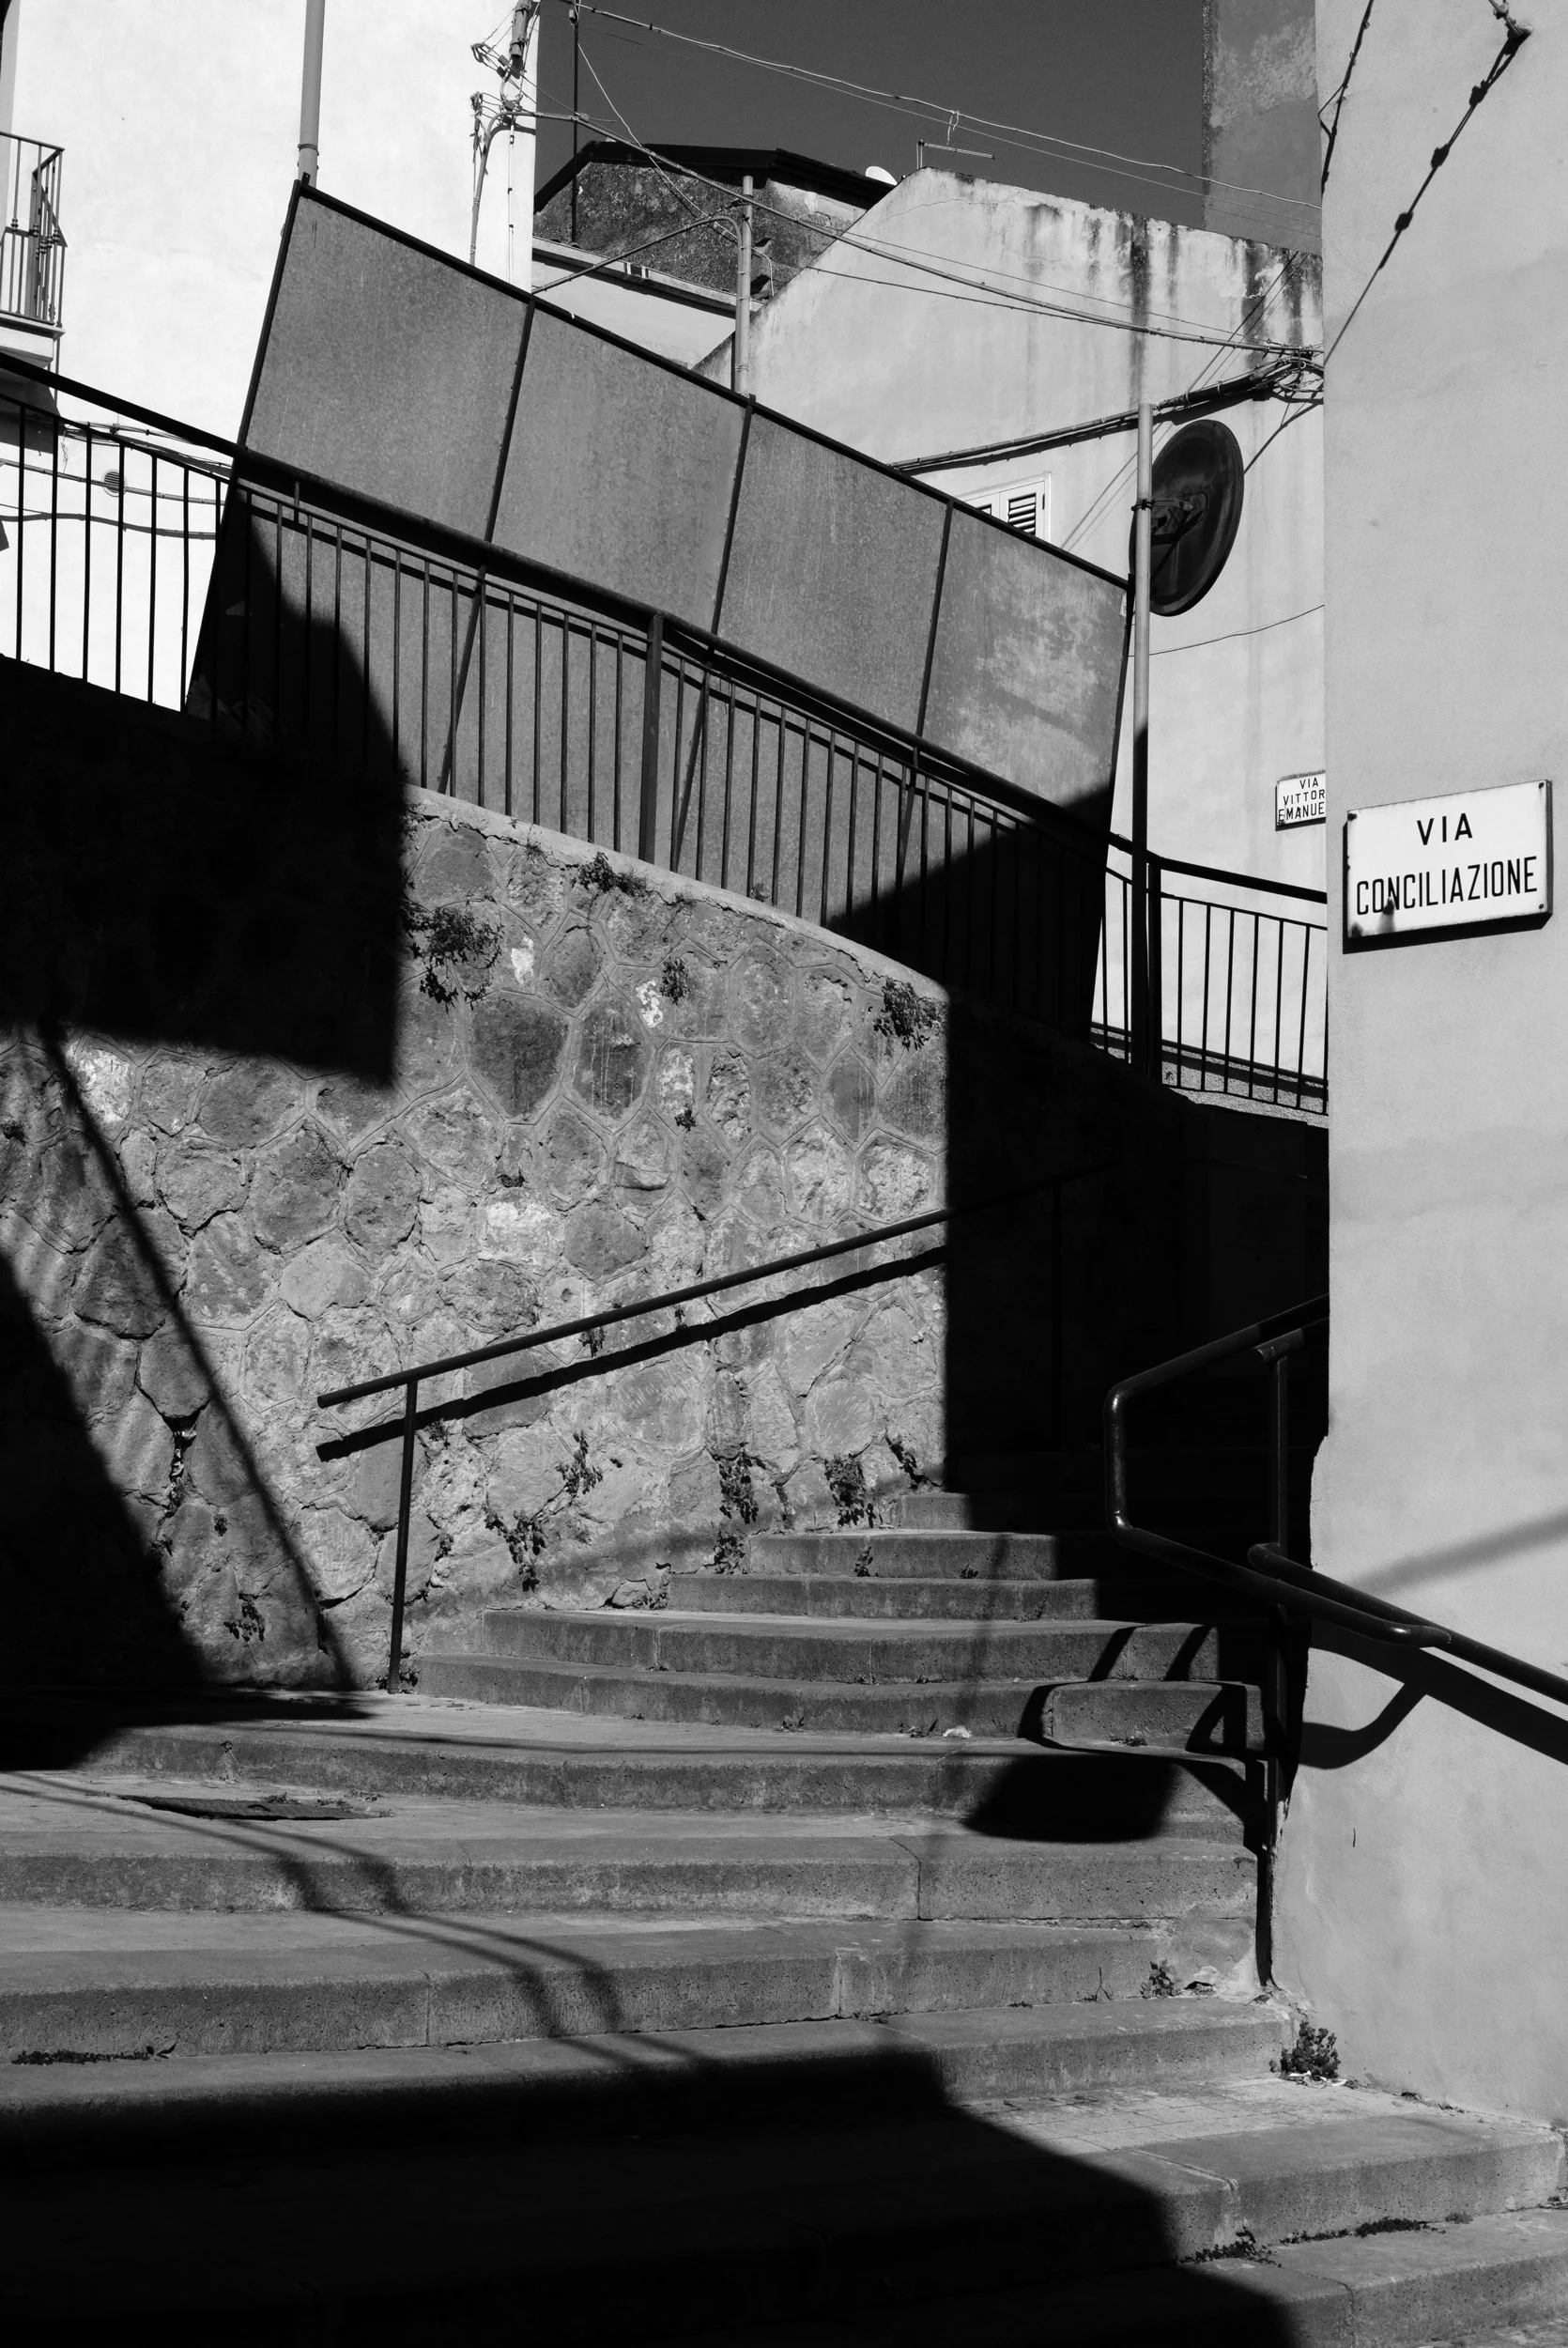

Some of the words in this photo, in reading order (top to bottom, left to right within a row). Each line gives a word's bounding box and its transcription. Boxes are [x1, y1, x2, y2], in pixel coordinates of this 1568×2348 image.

[1299, 778, 1318, 789] VIA
[1416, 812, 1473, 845] VIA
[1357, 856, 1538, 916] CONCILIAZIONE
